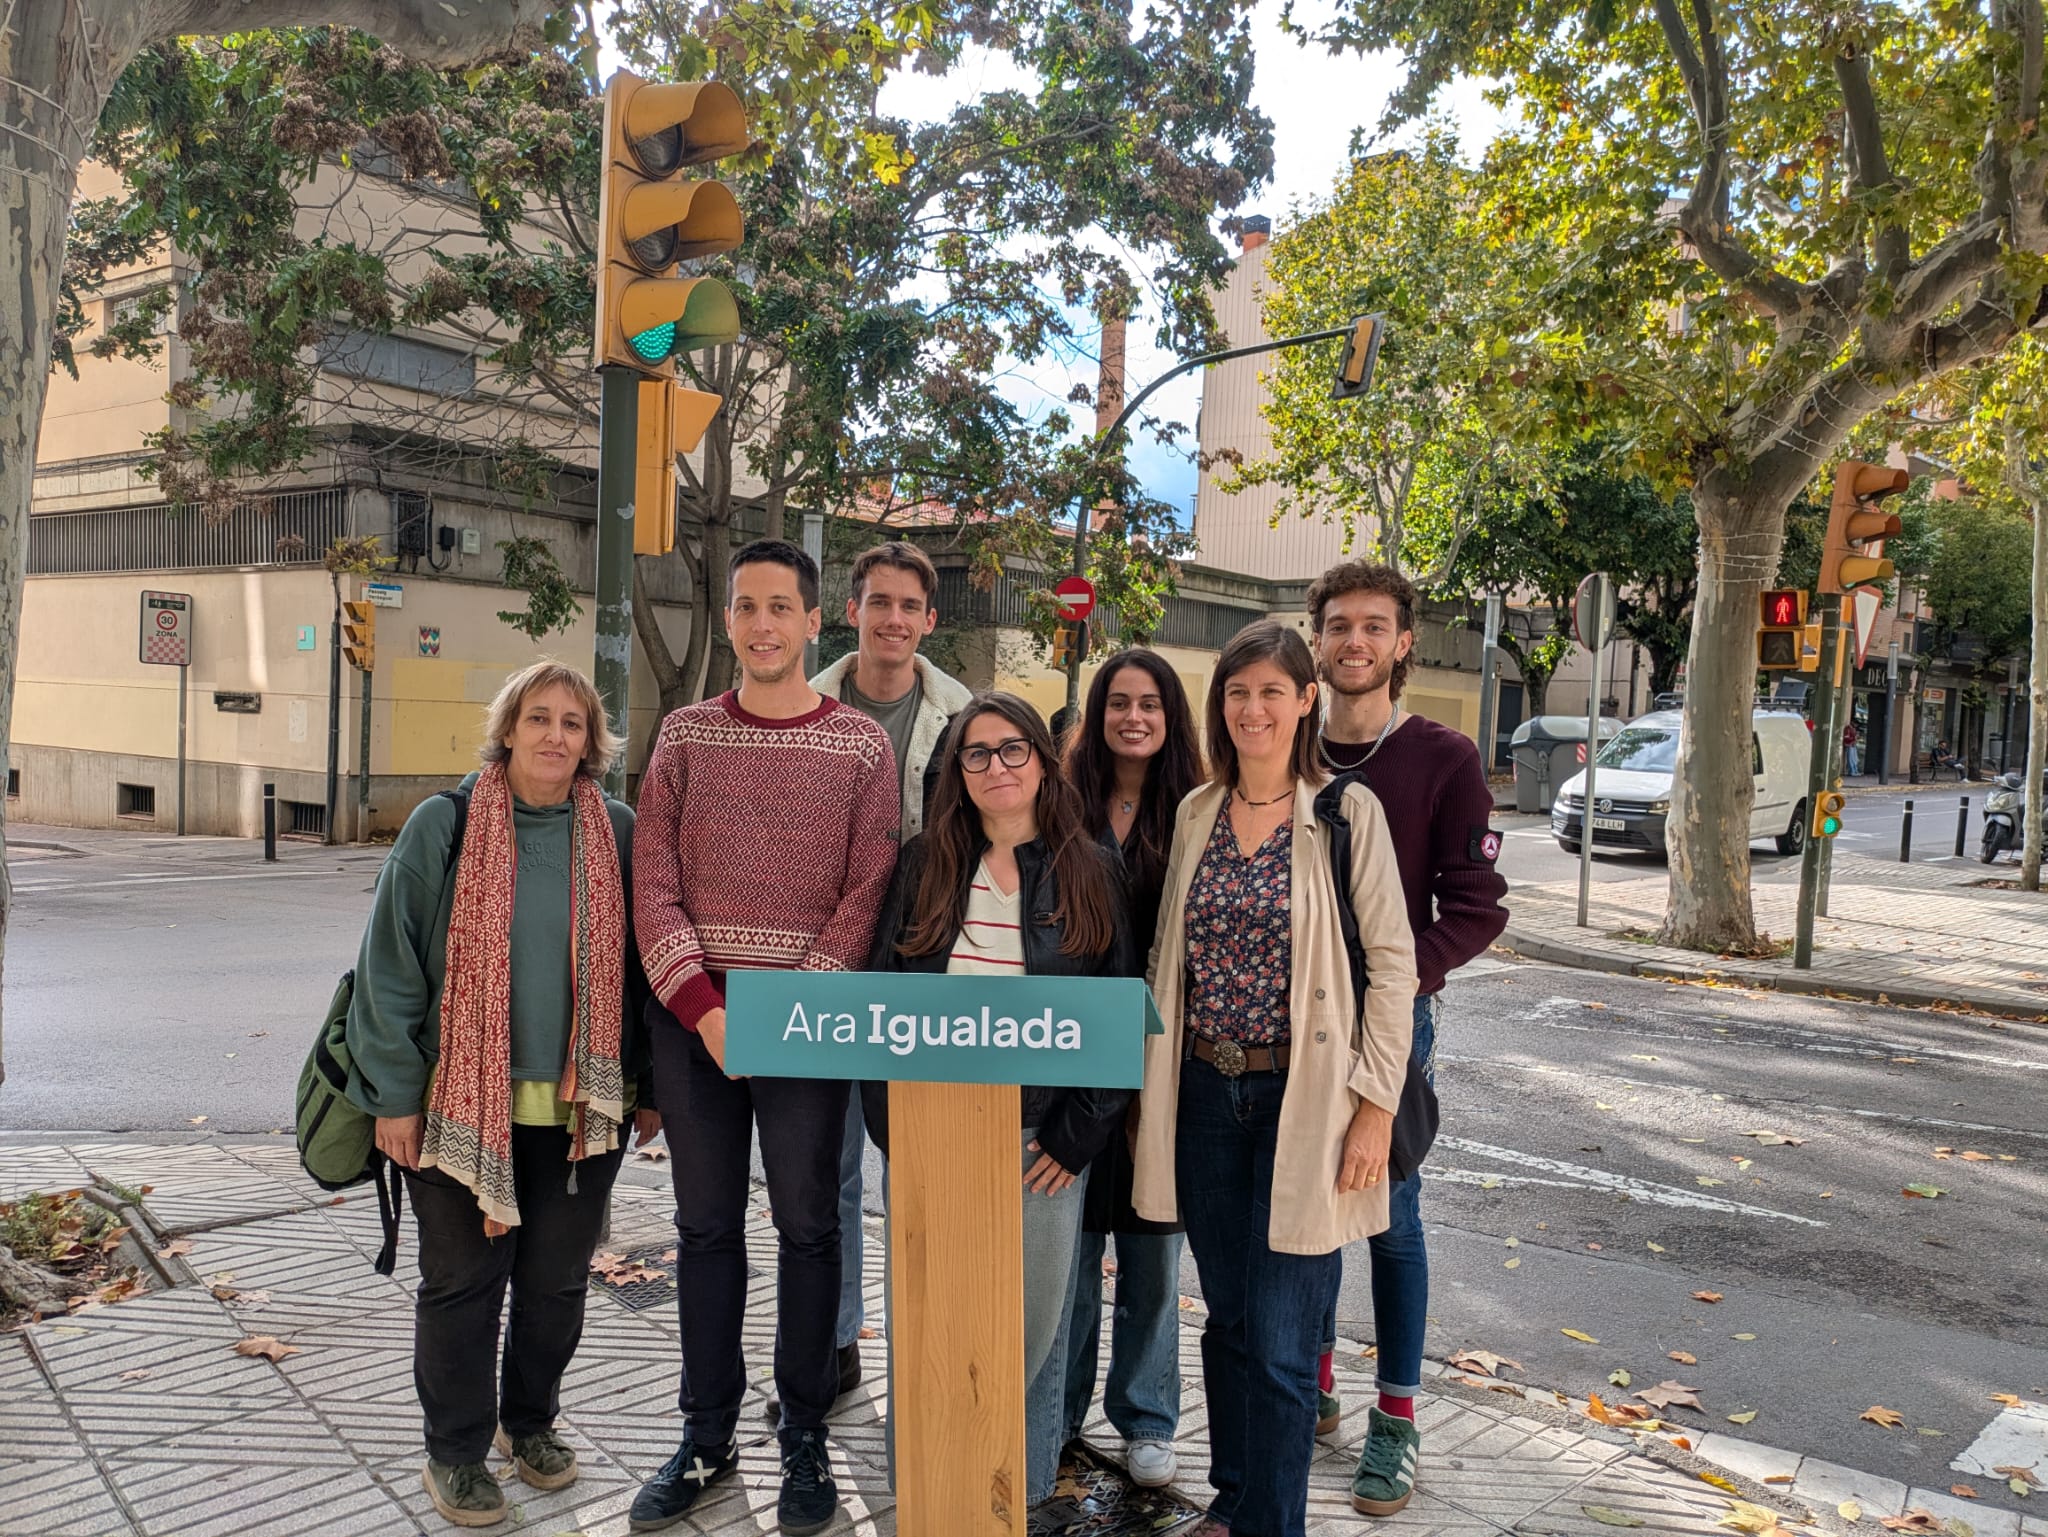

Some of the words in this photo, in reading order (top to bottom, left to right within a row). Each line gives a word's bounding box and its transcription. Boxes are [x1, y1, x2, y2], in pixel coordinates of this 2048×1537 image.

[161, 616, 173, 625] 30
[155, 630, 178, 638] ZONA
[1867, 668, 1903, 689] DECR
[1607, 820, 1623, 829] LLH
[782, 1002, 856, 1043] Ara
[867, 1003, 1082, 1056] Igualada
